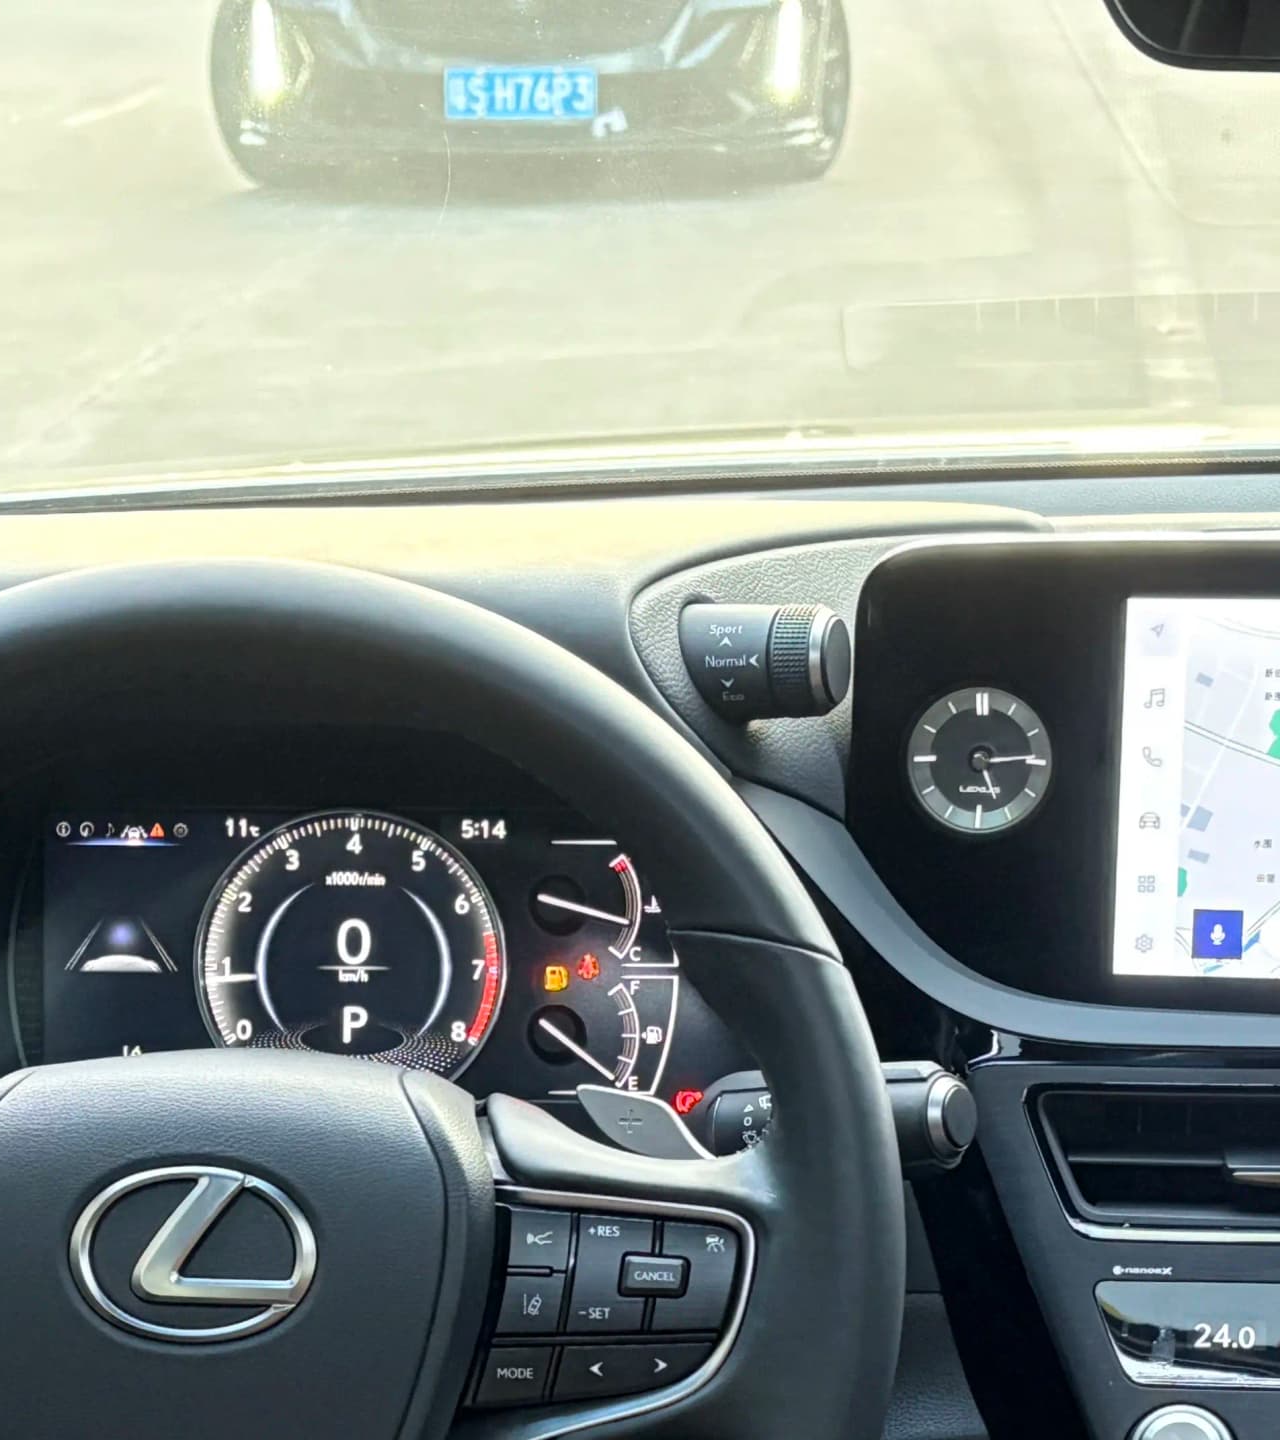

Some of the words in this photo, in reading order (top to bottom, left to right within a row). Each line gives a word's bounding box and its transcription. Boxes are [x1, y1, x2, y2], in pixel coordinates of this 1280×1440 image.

[710, 624, 742, 636] Sport
[705, 655, 746, 668] Normal
[722, 691, 744, 702] Eco
[461, 819, 507, 840] 5:14
[346, 832, 363, 855] 4
[285, 849, 300, 871] 3
[412, 851, 426, 872] 5
[237, 892, 252, 912] 2
[455, 894, 469, 915] 6
[336, 917, 372, 966] 0
[629, 948, 642, 962] C
[221, 957, 232, 976] 1
[338, 968, 369, 984] km/h
[472, 960, 484, 981] 7
[630, 980, 641, 995] F
[236, 1019, 252, 1040] 0
[342, 1006, 368, 1044] P
[450, 1021, 467, 1041] 8
[628, 1076, 638, 1091] E
[634, 1271, 676, 1283] CANCEL
[1193, 1323, 1257, 1351] 24.0
[496, 1367, 534, 1380] MODE
